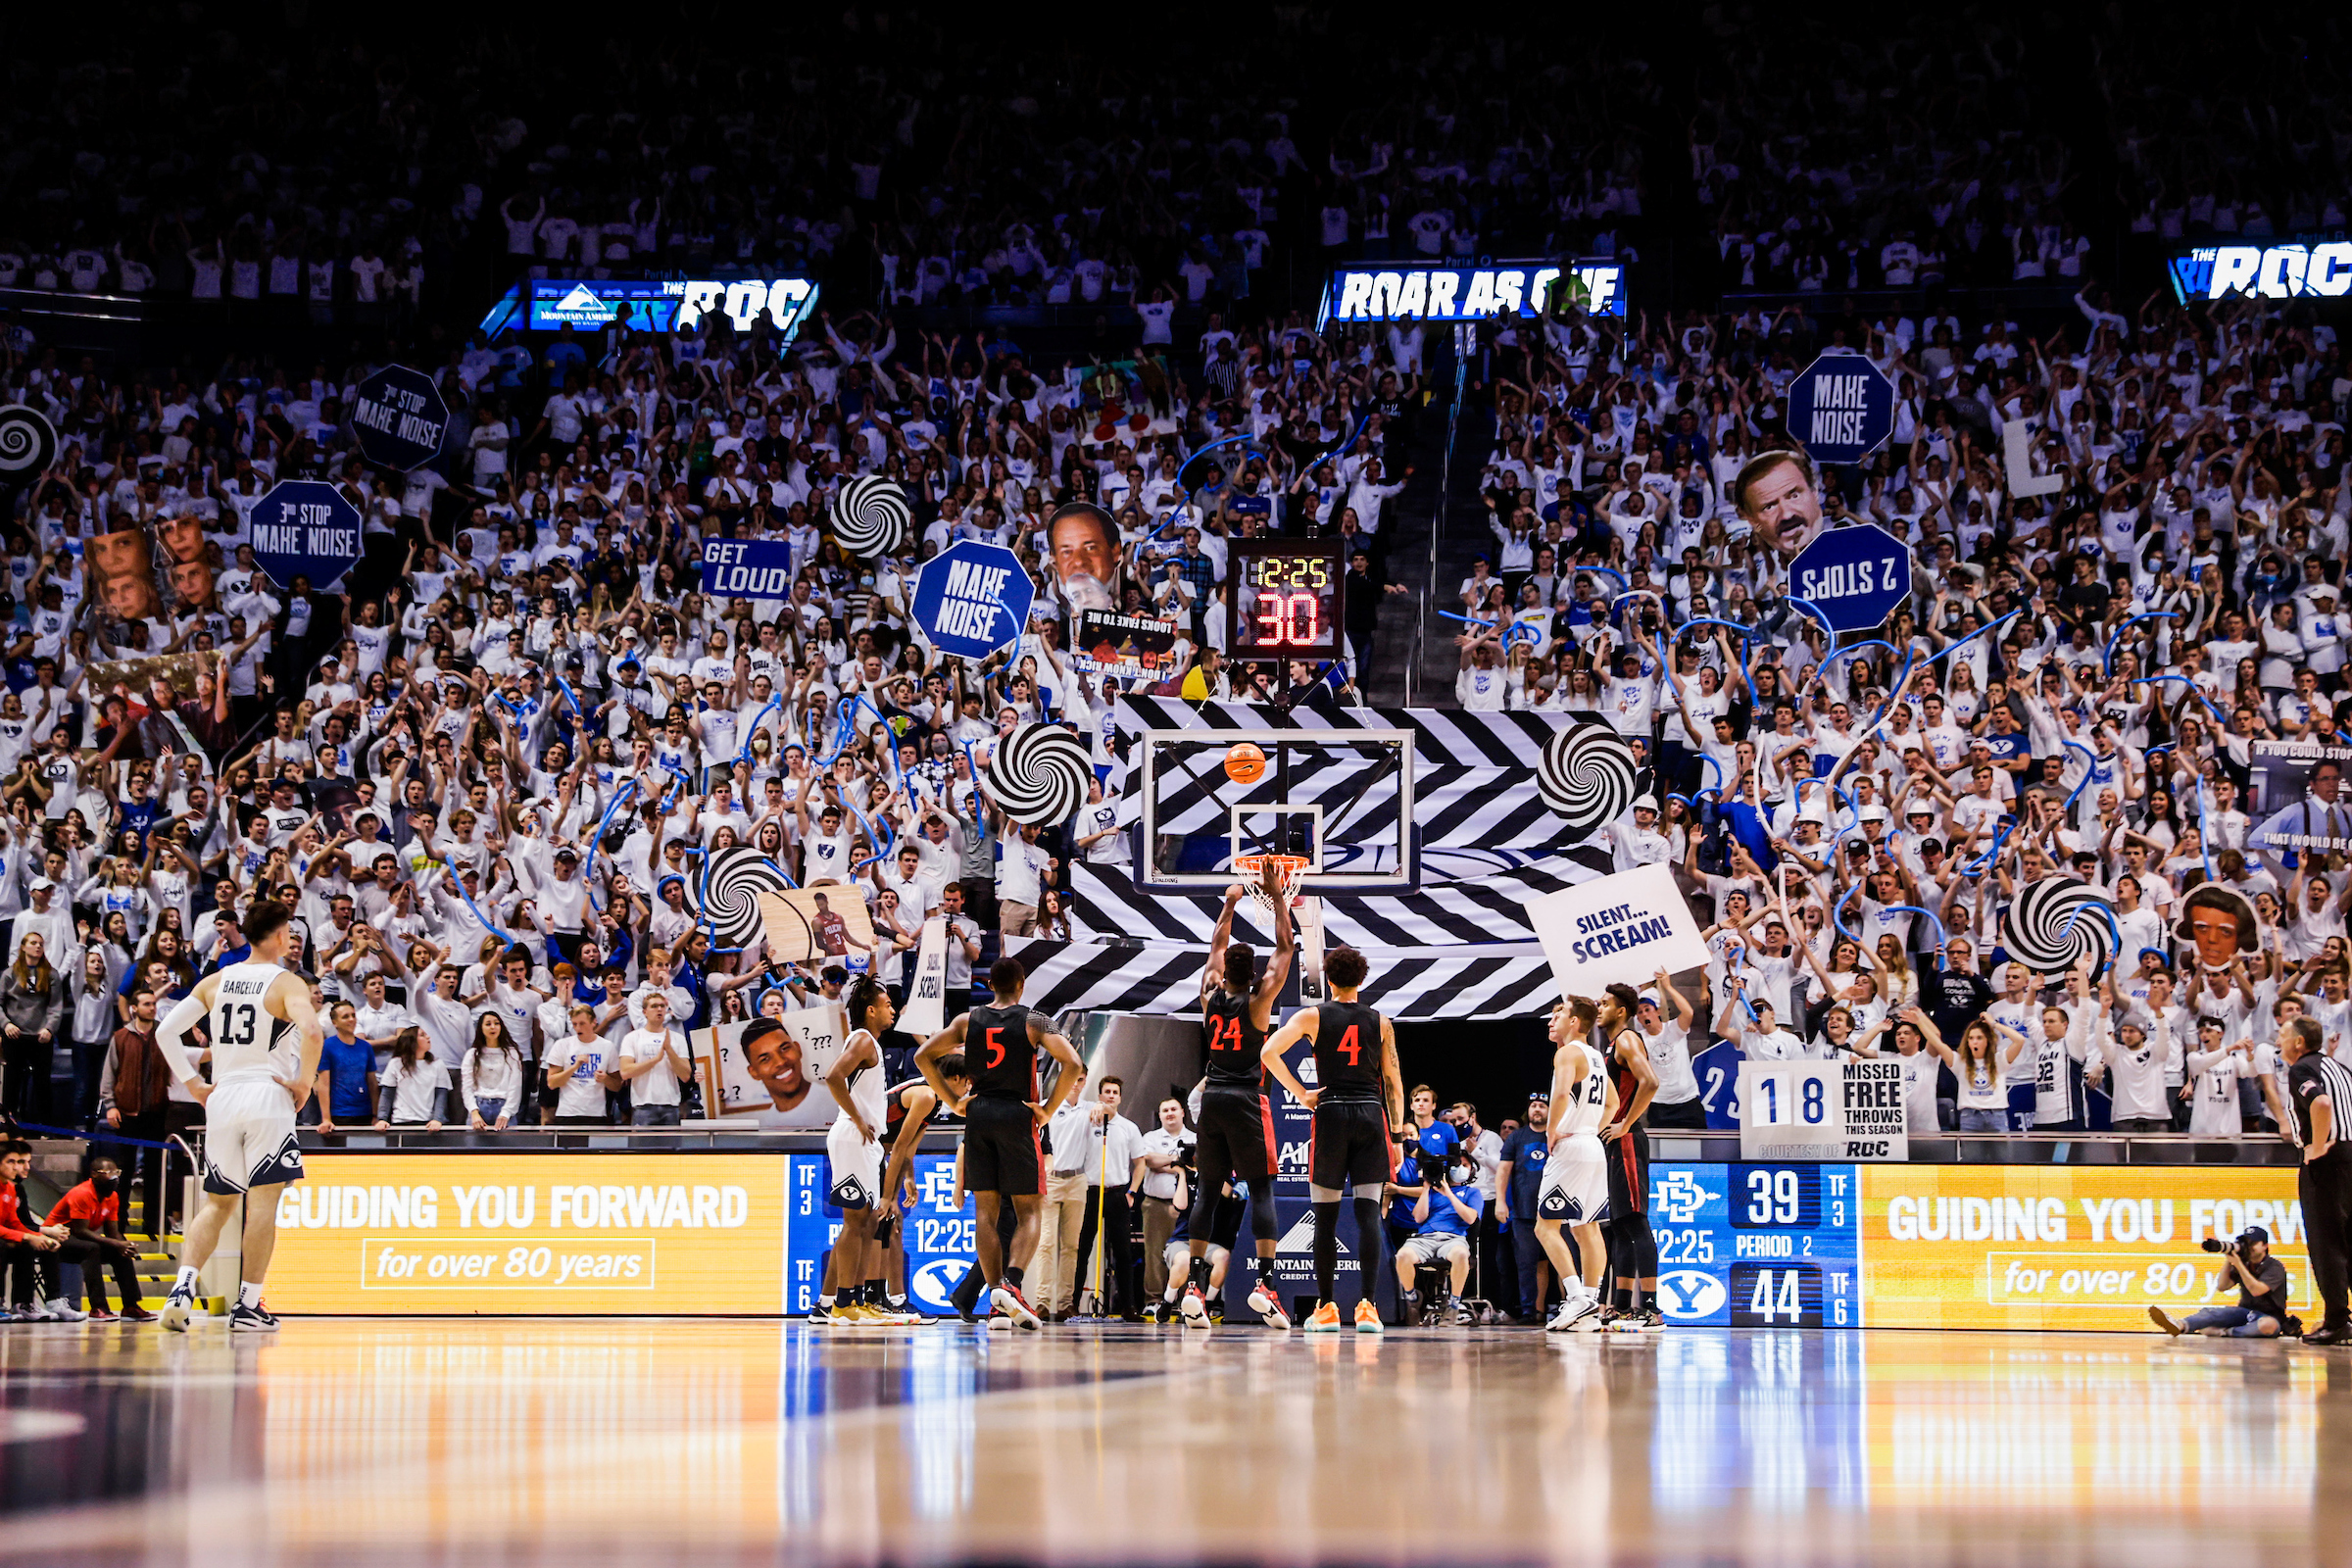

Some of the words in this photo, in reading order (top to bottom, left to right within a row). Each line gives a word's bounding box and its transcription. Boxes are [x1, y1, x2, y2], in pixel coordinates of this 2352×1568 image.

[1446, 256, 1474, 268] Portal
[2191, 248, 2217, 262] THE
[2209, 241, 2352, 299] ROC
[662, 280, 684, 295] THE
[677, 278, 810, 331] ROC
[1339, 270, 1460, 318] ROAR
[1462, 270, 1525, 316] AS
[585, 310, 617, 321] AMERIC
[397, 390, 426, 415] STOP
[1813, 374, 1870, 410] MAKE
[354, 397, 397, 435] MAKE
[397, 413, 442, 450] NOISE
[1810, 411, 1867, 445] NOISE
[300, 503, 332, 526] STOP
[253, 523, 302, 555] MAKE
[307, 527, 357, 558] NOISE
[705, 542, 749, 565] GET
[713, 566, 787, 595] LOUD
[944, 559, 1012, 604] MAKE
[1257, 558, 1327, 588] 12:25
[1802, 561, 1875, 602] STOPS
[1881, 557, 1897, 591] 2
[934, 597, 1003, 643] NOISE
[1087, 612, 1102, 624] ME
[1102, 613, 1116, 626] TO
[1117, 615, 1141, 629] FAKE
[1141, 619, 1172, 634] LOOKS
[1256, 593, 1318, 646] 30
[1079, 660, 1102, 672] RICK
[1103, 662, 1134, 676] KNOW
[1134, 668, 1161, 681] DON'T
[2256, 744, 2267, 756] IF
[2267, 745, 2289, 757] YOU
[2289, 746, 2326, 759] COULD
[2263, 832, 2290, 845] THAT
[2291, 834, 2330, 849] WOULD
[2332, 837, 2347, 850] BE
[1576, 903, 1648, 934] SILENT...
[1572, 914, 1673, 964] SCREAM!
[222, 980, 265, 995] BARCELLO
[220, 1003, 256, 1045] 13
[1208, 1013, 1243, 1053] 24
[985, 1027, 1006, 1069] 5
[1337, 1024, 1362, 1066] 4
[1842, 1063, 1900, 1080] MISSED
[1588, 1074, 1603, 1104] 21
[1843, 1081, 1901, 1108] FREE
[1844, 1109, 1902, 1124] THROWS
[1844, 1125, 1866, 1135] THIS
[1868, 1125, 1903, 1135] SEASON
[1759, 1144, 1821, 1158] COURTESY
[1823, 1144, 1839, 1157] OF
[1846, 1141, 1889, 1157] ROC
[798, 1164, 815, 1186] TF
[1828, 1174, 1847, 1197] TF
[274, 1185, 438, 1229] GUIDING
[452, 1186, 535, 1229] YOU
[551, 1186, 748, 1229] FORWARD
[800, 1190, 812, 1215] 3
[1746, 1169, 1799, 1224] 39
[1832, 1200, 1844, 1227] 3
[1887, 1196, 2068, 1243] GUIDING
[2080, 1198, 2174, 1244] YOU
[914, 1218, 977, 1253] 12:25
[1736, 1235, 1792, 1257] PERIOD
[1802, 1235, 1813, 1256] 2
[376, 1247, 413, 1279] for
[417, 1252, 497, 1279] over
[505, 1247, 552, 1279] 80
[554, 1252, 642, 1287] years
[796, 1259, 815, 1281] TF
[2004, 1261, 2052, 1294] for
[2059, 1268, 2133, 1295] over
[2143, 1262, 2196, 1295] 80
[799, 1284, 811, 1310] 6
[1750, 1269, 1802, 1324] 44
[1830, 1272, 1849, 1295] TF
[1834, 1298, 1847, 1325] 6
